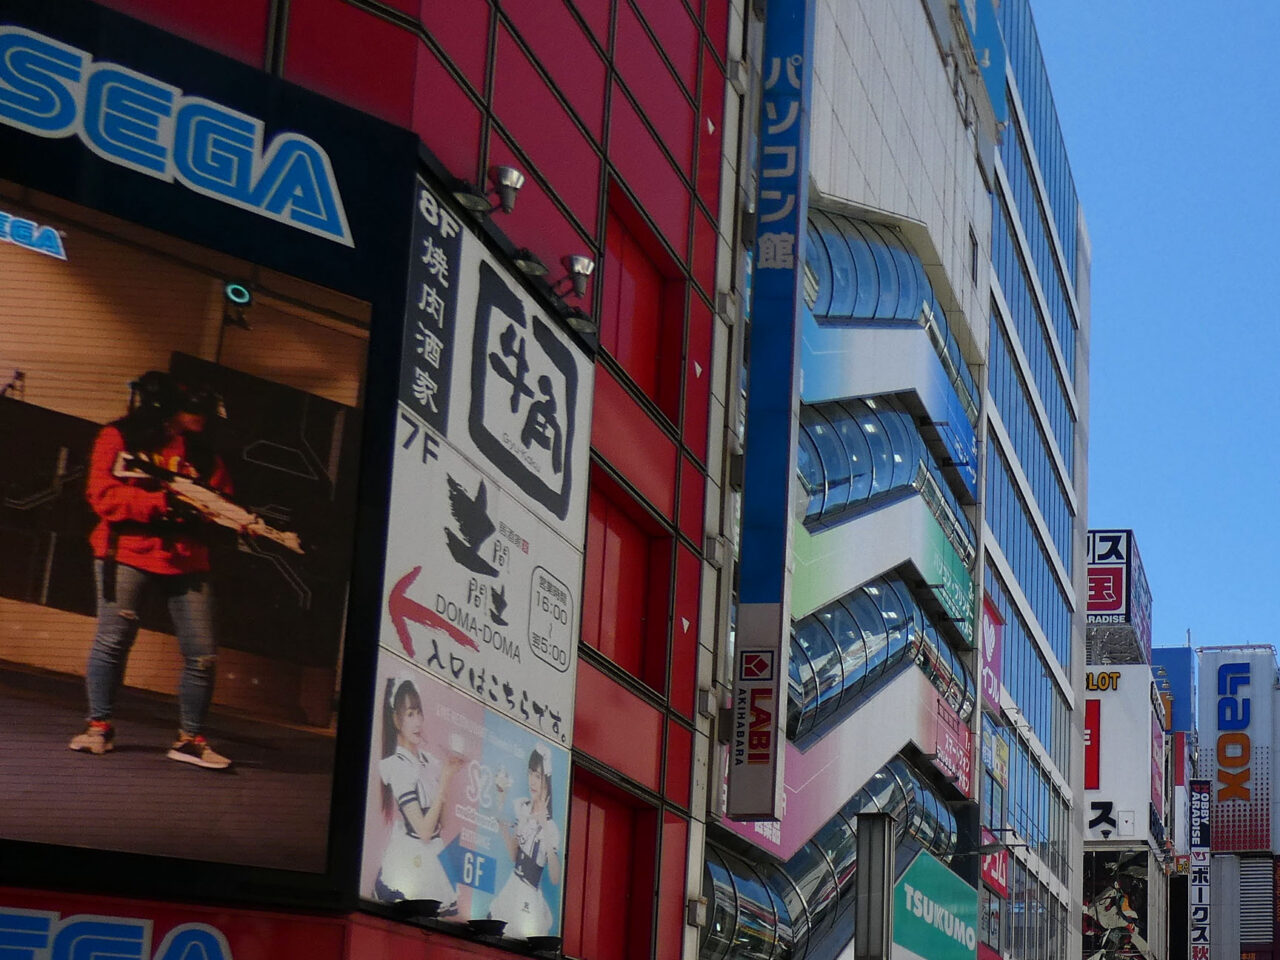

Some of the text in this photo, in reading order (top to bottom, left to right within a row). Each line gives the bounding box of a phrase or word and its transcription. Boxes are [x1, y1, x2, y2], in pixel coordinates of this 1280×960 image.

[0, 25, 355, 248] SEGA
[757, 55, 804, 270] パソコン館
[420, 189, 460, 239] 8F
[412, 237, 449, 413] 焼肉酒家
[488, 323, 563, 475] 牛角
[401, 413, 440, 464] 7F
[435, 594, 522, 663] DOMA-DOMA
[536, 590, 569, 626] 16:00
[426, 639, 567, 744] 入口はこちらです。
[1086, 671, 1121, 692] LOT
[734, 688, 747, 767] AKIHABARA
[748, 688, 772, 765] LABI
[1191, 783, 1201, 846] PARADISE
[1200, 783, 1210, 825] HOBBY
[462, 851, 486, 888] 6F
[903, 883, 976, 951] TSUKUMO
